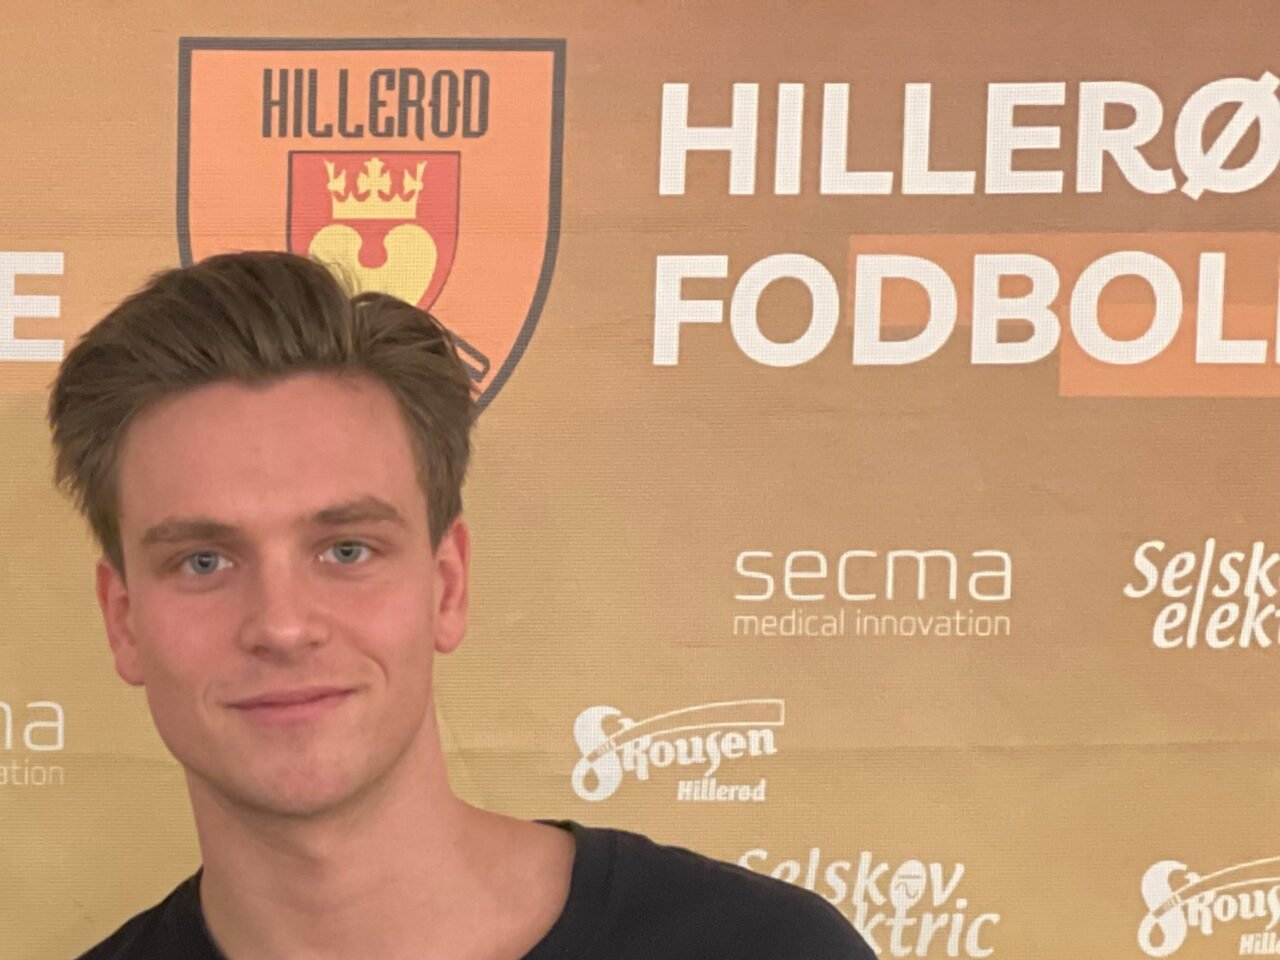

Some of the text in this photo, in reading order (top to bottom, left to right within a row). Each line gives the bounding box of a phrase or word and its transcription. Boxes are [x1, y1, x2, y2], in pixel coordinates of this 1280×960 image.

[658, 71, 1280, 200] HILLERØ
[652, 251, 1280, 367] FODBOL
[733, 549, 1013, 601] secma
[732, 607, 1012, 637] medical innovation
[1152, 593, 1280, 649] elek
[852, 897, 1001, 958] ktric
